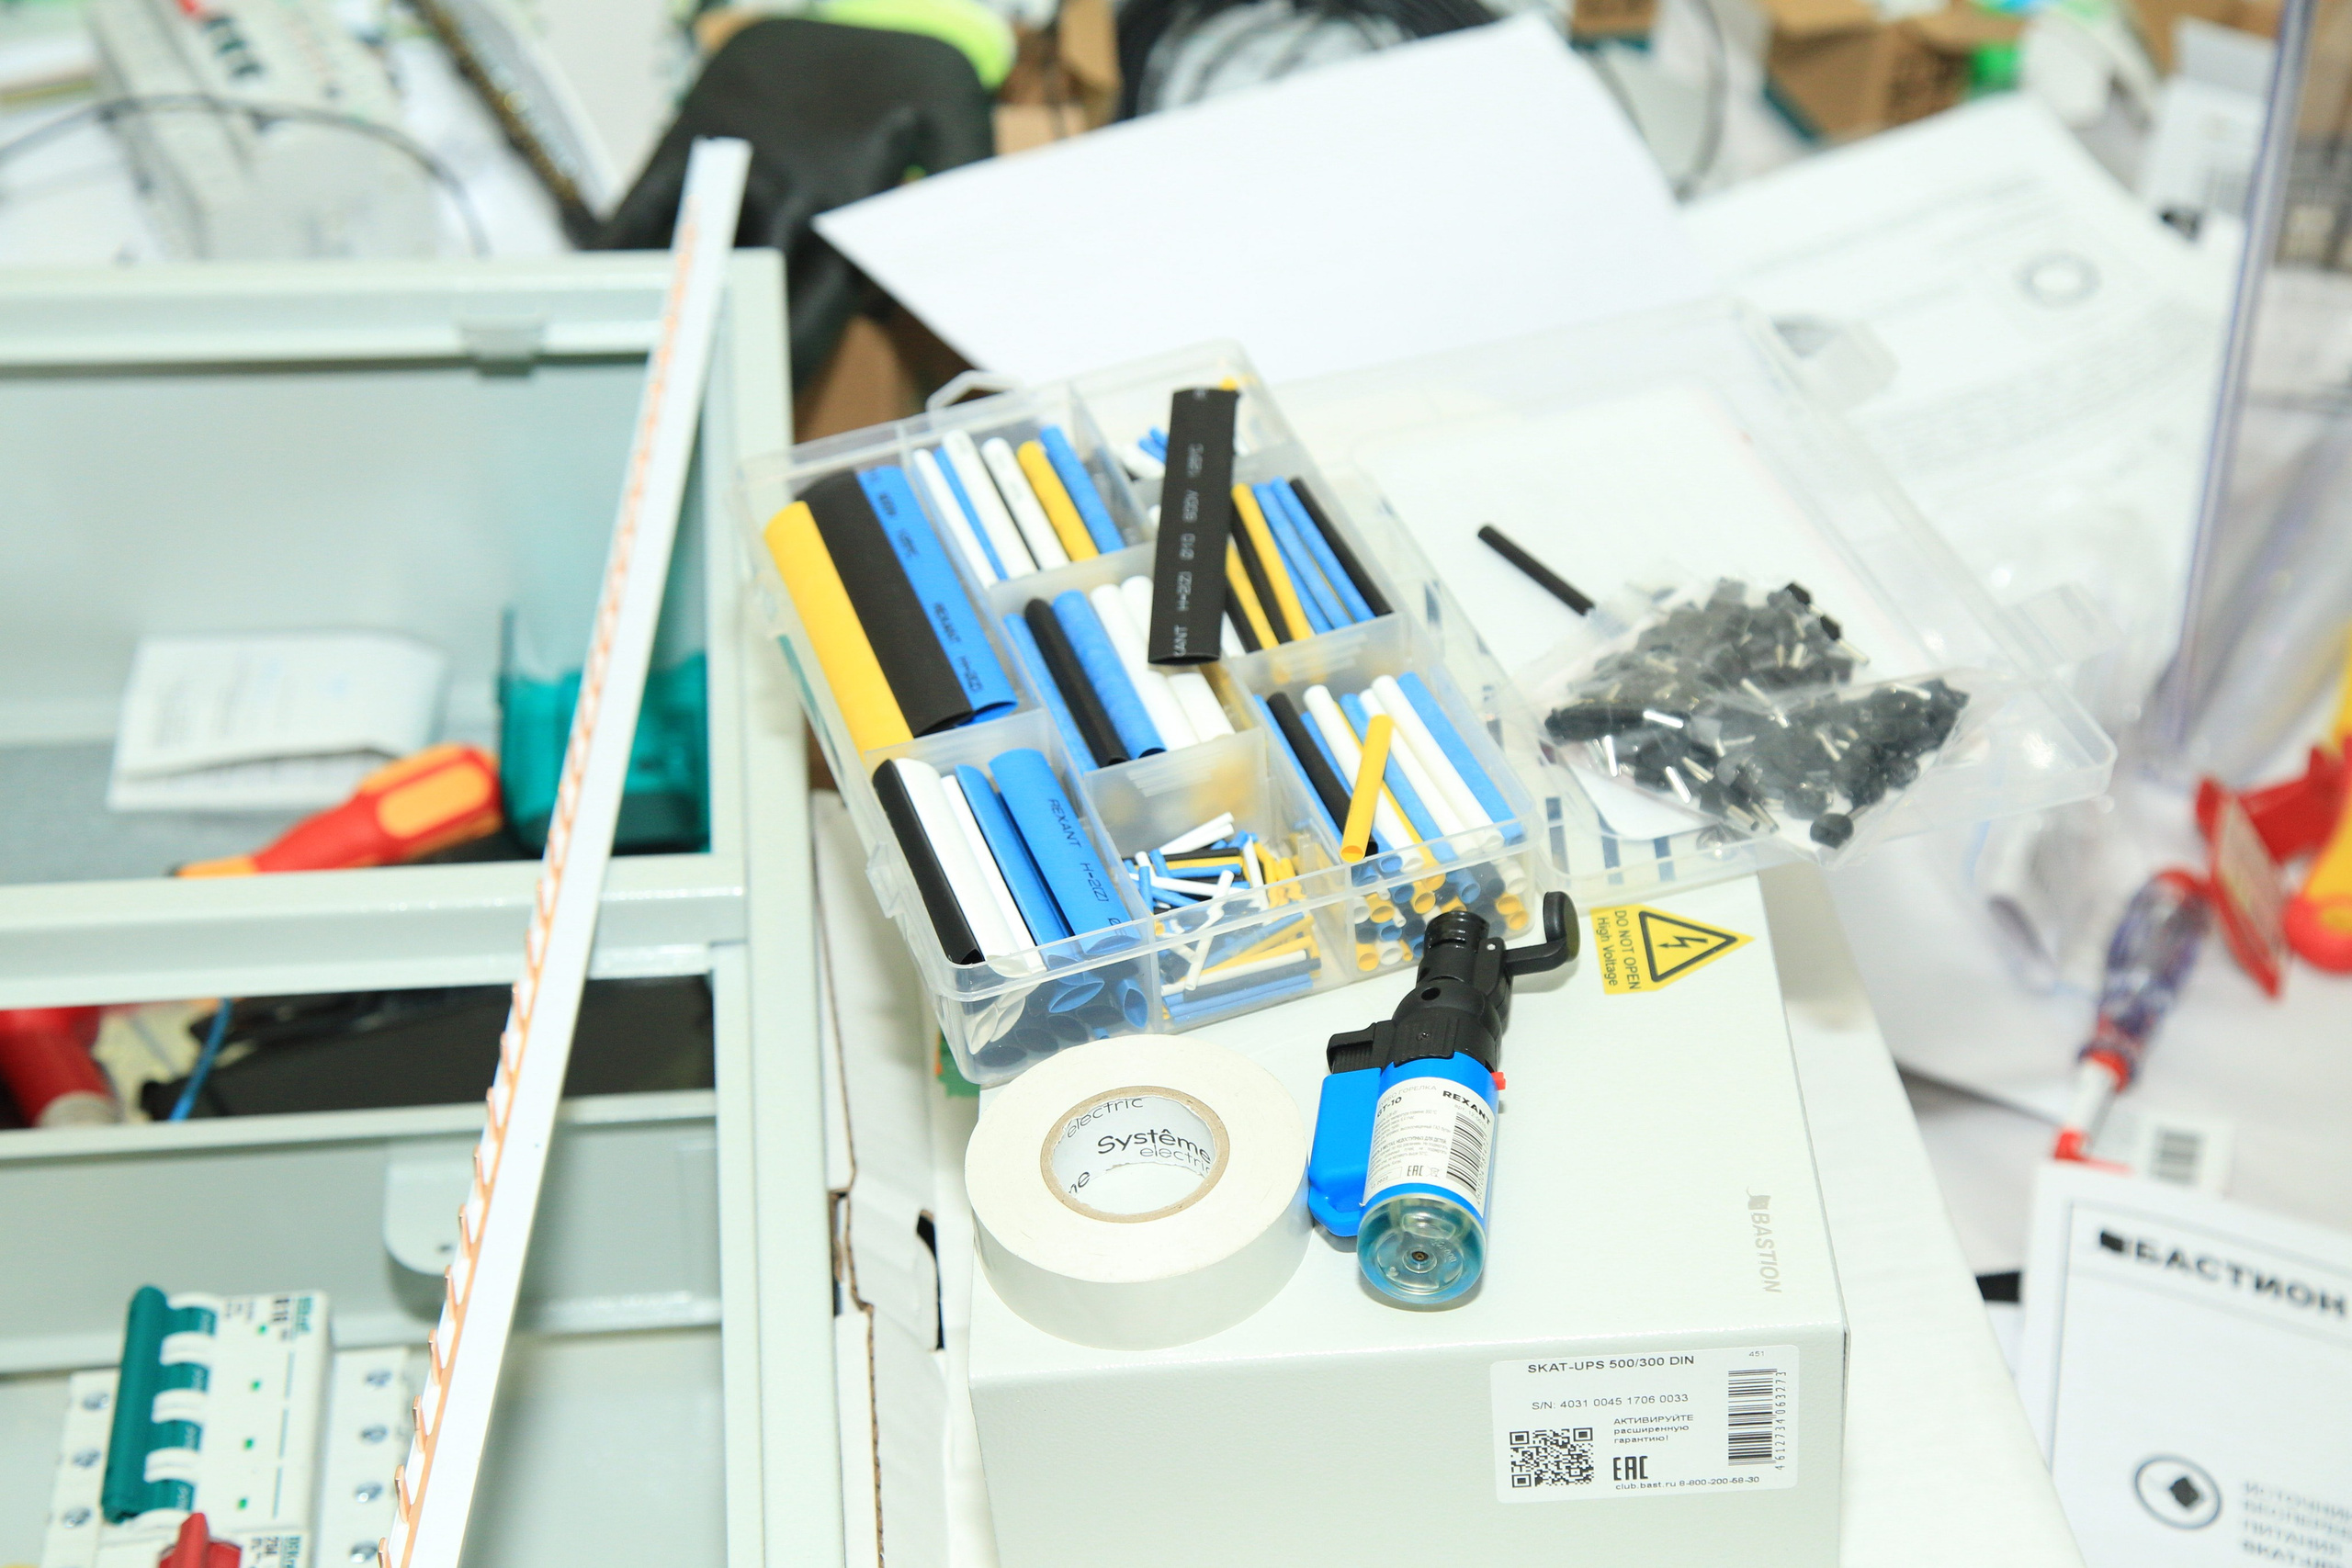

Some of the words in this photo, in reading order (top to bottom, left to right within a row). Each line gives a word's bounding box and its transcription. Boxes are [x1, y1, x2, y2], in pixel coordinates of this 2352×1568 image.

[1048, 798, 1081, 848] REXANT
[1596, 917, 1611, 942] High
[1614, 909, 1629, 927] DO
[1618, 930, 1634, 954] NOT
[1602, 945, 1618, 987] Voltage
[1623, 957, 1642, 990] OPEN
[1067, 1098, 1144, 1138] electric
[1377, 1096, 1402, 1118] GT-10
[1442, 1090, 1491, 1125] REXANT
[1097, 1129, 1212, 1164] Système
[1407, 1165, 1424, 1177] EAC
[1751, 1213, 1782, 1293] BASTION
[2135, 1239, 2348, 1316] БАСТИОН
[1528, 1360, 1605, 1373] SKAT-UPS
[1609, 1357, 1665, 1369] 500/300
[1669, 1355, 1695, 1366] DIN
[1532, 1401, 1555, 1410] S/N:
[1560, 1399, 1589, 1409] 4031
[1593, 1397, 1623, 1407] 0045
[1627, 1395, 1656, 1405] 1706
[1659, 1393, 1689, 1404] 0033
[1613, 1414, 1694, 1425] АКТИВИРУЙТЕ
[1614, 1425, 1690, 1436] расширенную
[1614, 1435, 1668, 1444] гарантию!
[1613, 1456, 1648, 1481] EAC
[1615, 1481, 1677, 1490] club.bast.ru
